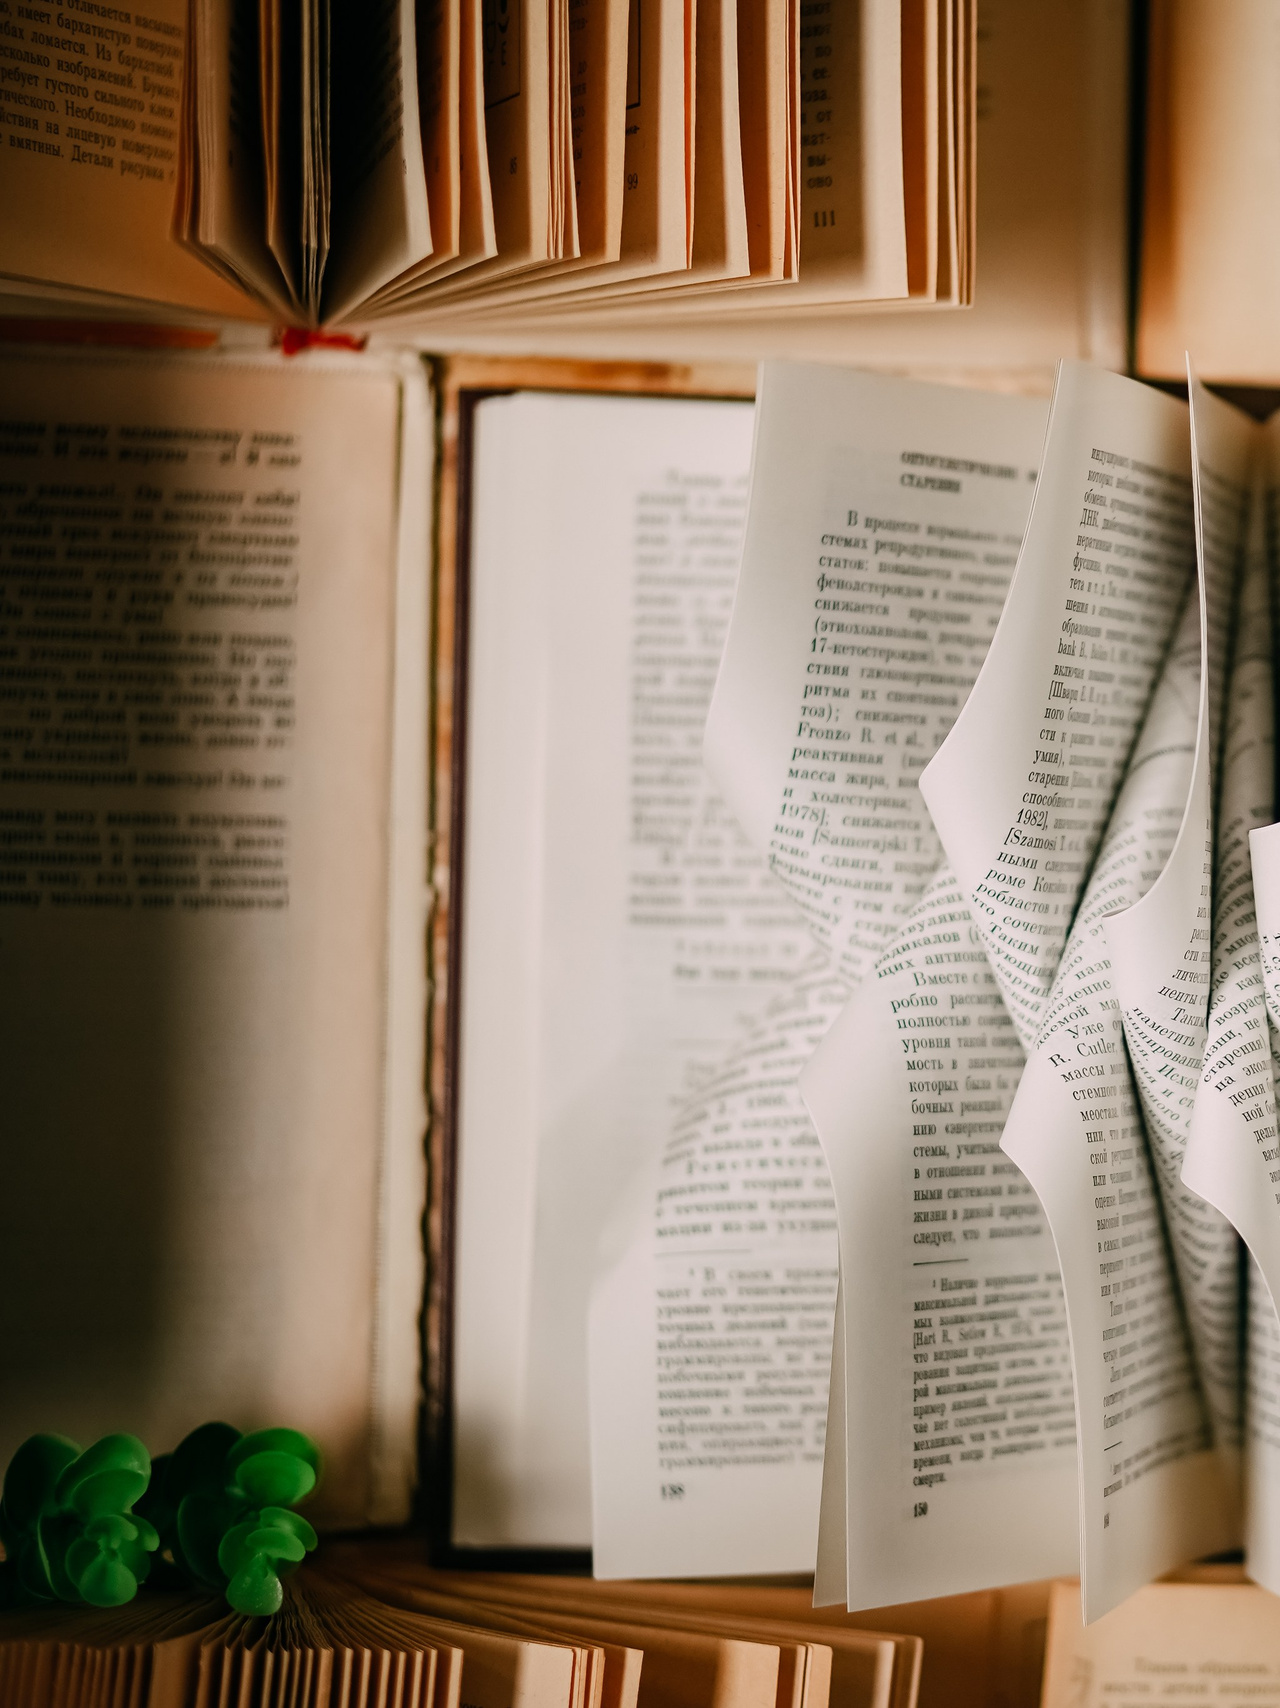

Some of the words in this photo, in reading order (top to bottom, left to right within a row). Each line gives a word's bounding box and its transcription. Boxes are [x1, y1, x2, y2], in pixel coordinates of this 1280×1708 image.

[18, 6, 51, 24] имеет
[96, 43, 112, 61] Из
[45, 77, 89, 98] густого
[46, 121, 59, 135] на
[72, 145, 113, 167] Детали
[628, 173, 638, 189] 99
[814, 210, 835, 227] 111
[803, 684, 850, 699] ритма
[796, 721, 851, 741] Fronzo
[1039, 728, 1056, 741] сти
[791, 746, 883, 765] реактивная
[788, 767, 836, 783] масса
[1015, 808, 1048, 831] 1982],
[996, 852, 1038, 870] ными
[984, 868, 1025, 889] роме
[988, 922, 1040, 956] Таким
[913, 972, 968, 987] Вместе
[890, 992, 938, 1013] робно
[897, 1014, 970, 1029] полностью
[1065, 1020, 1104, 1040] Уже
[901, 1036, 951, 1053] уровня
[1077, 1037, 1118, 1057] Cutler,
[906, 1059, 943, 1070] мость
[1061, 1064, 1105, 1083] массы
[909, 1079, 958, 1095] которых
[1214, 1075, 1236, 1092] на
[1228, 1082, 1266, 1107] дения
[911, 1099, 954, 1114] бочных
[1242, 1102, 1265, 1122] ной
[913, 1123, 936, 1136] нию
[913, 1144, 949, 1159] стемы,
[914, 1168, 920, 1179] в
[914, 1189, 943, 1201] ными
[913, 1210, 947, 1223] жизни
[913, 1332, 936, 1349] [Hart
[913, 1352, 928, 1363] что
